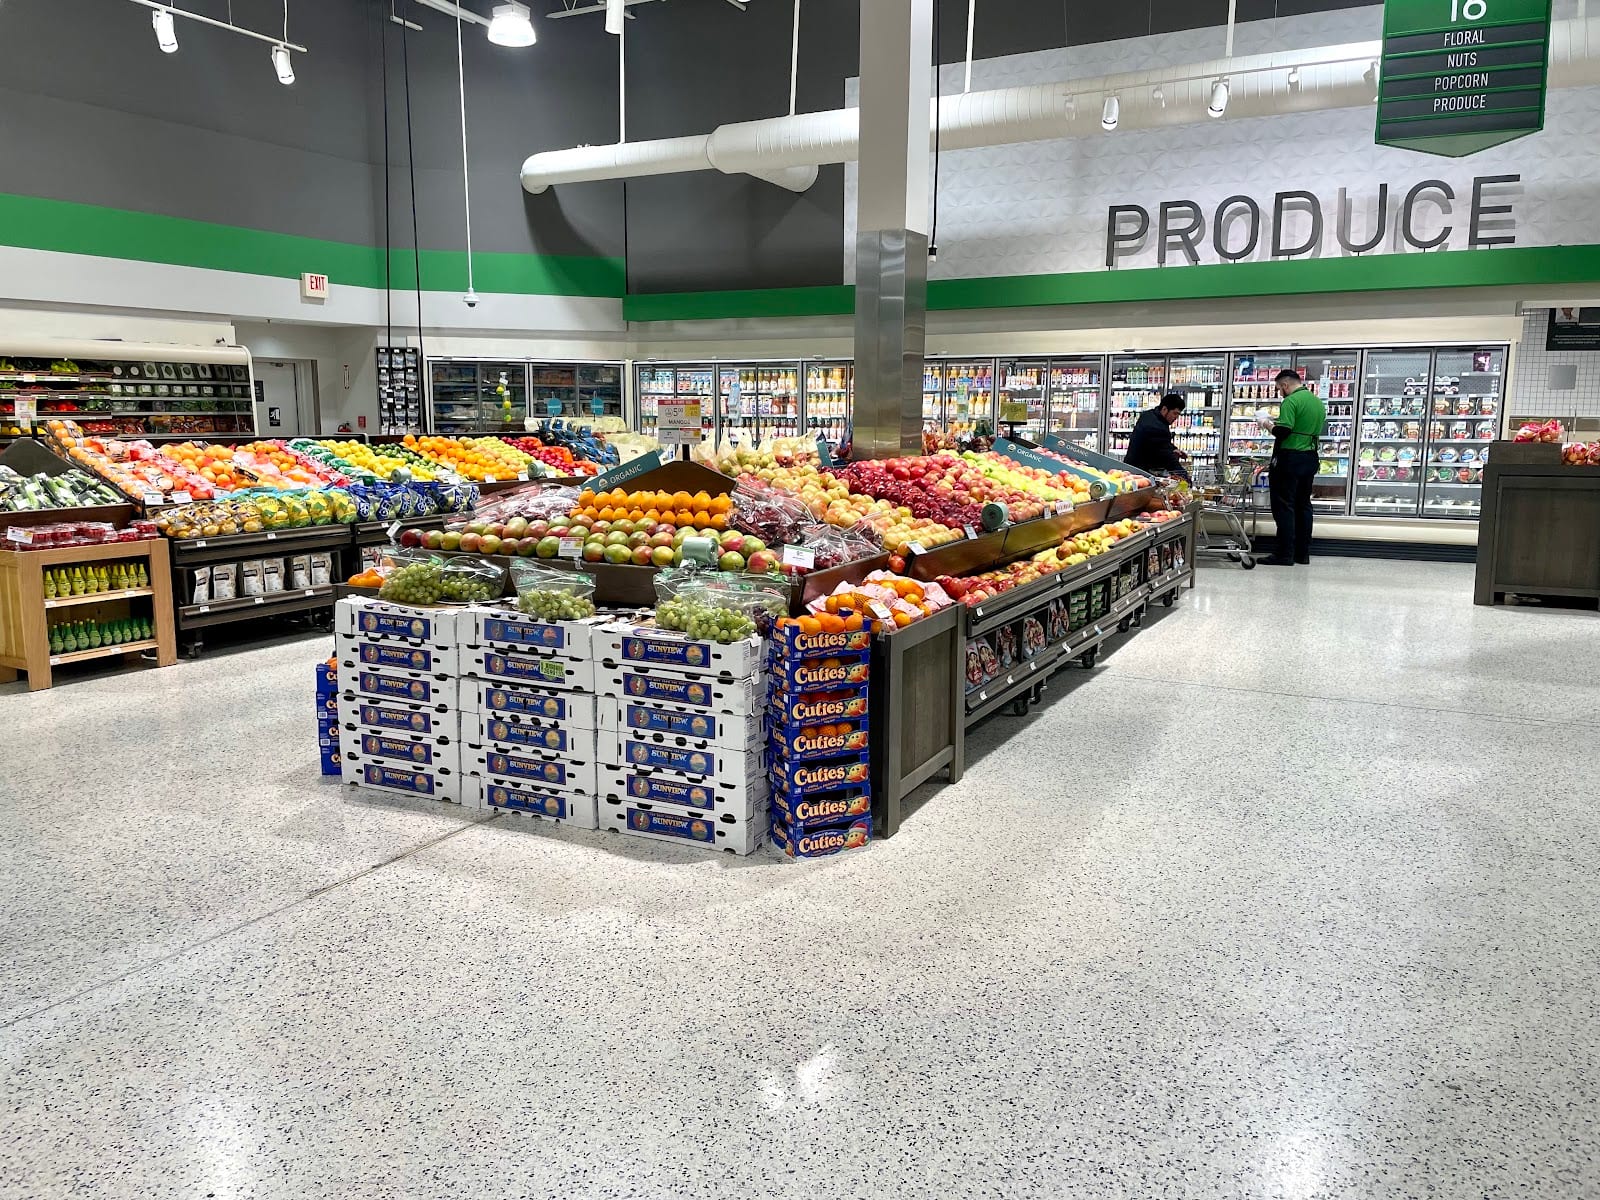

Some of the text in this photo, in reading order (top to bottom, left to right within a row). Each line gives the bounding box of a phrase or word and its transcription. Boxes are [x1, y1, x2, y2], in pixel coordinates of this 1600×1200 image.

[1444, 30, 1485, 46] FLORAL
[1447, 52, 1477, 68] NUTS
[1434, 73, 1489, 91] POPCORN
[1433, 94, 1487, 112] PRODUCE
[1105, 174, 1521, 267] PRODUCE
[310, 275, 325, 291] EXIT
[1017, 448, 1043, 462] ORGANIC
[1066, 445, 1089, 457] ORGANIC
[610, 464, 643, 484] ORGANIC
[647, 645, 683, 655] SUNVIEW
[794, 633, 847, 651] Cuties
[507, 661, 539, 671] SUNVIEW
[794, 667, 847, 685] Cuties
[649, 681, 685, 693] SUNVIEW
[792, 701, 844, 720] Cuties
[793, 735, 845, 753] Cuties
[509, 761, 542, 771] SUNVIEW
[794, 766, 846, 786] Cuties
[652, 784, 688, 796] SUNVIEW
[796, 800, 847, 820] Cuties
[652, 816, 689, 829] SUNVIEW
[799, 833, 845, 853] Cuties
